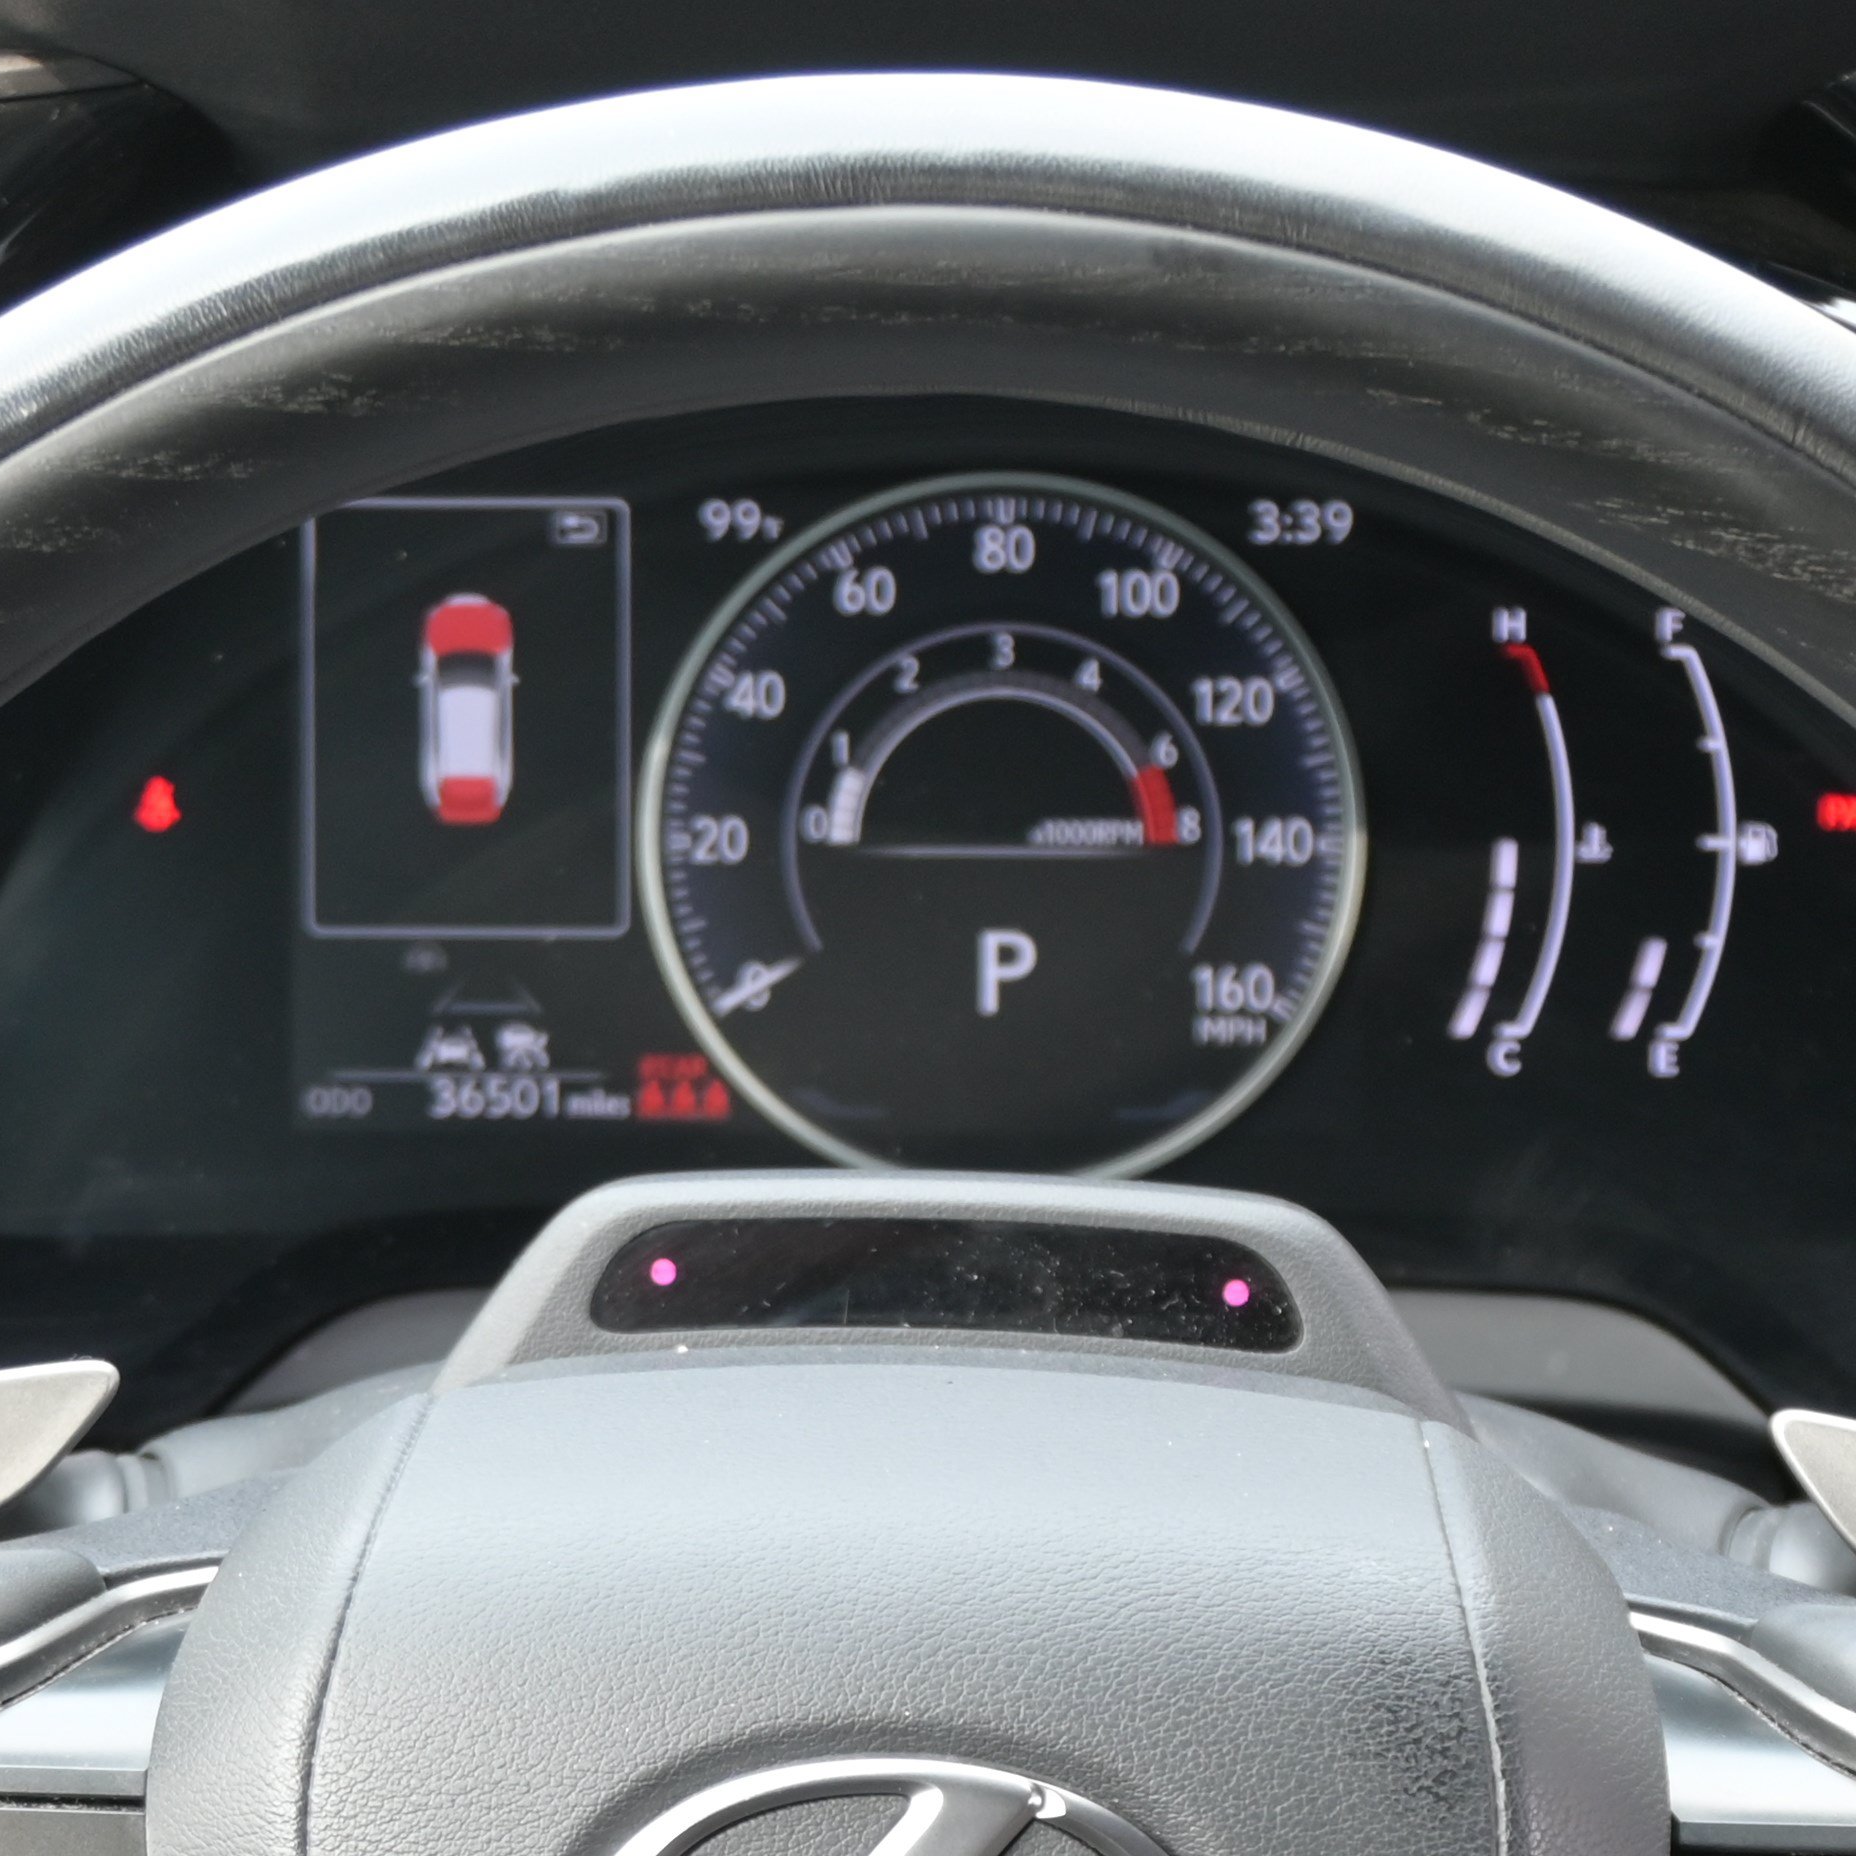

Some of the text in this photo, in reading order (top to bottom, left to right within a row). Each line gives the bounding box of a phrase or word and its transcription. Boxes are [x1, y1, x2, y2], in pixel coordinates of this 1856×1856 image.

[1249, 501, 1353, 547] 3:39
[973, 527, 1036, 574] 80
[832, 570, 895, 617] 60
[1097, 570, 1182, 617] 100
[1491, 606, 1527, 642] H
[1654, 606, 1685, 642] F
[990, 632, 1015, 669] 3
[894, 655, 920, 693] 2
[1076, 658, 1102, 693] 4
[727, 672, 786, 719] 40
[1193, 680, 1273, 728] 120
[832, 730, 850, 766] 1
[1150, 732, 1178, 768] 6
[691, 817, 748, 865] 20
[802, 805, 830, 842] 0
[1177, 806, 1201, 844] 8
[1235, 818, 1313, 865] 140
[977, 929, 1037, 1015] P
[1193, 965, 1273, 1013] 160
[1195, 1015, 1266, 1046] MPH
[1486, 1040, 1522, 1076] C
[1647, 1040, 1679, 1077] E
[428, 1075, 561, 1120] 36501
[564, 1090, 631, 1119] miles
